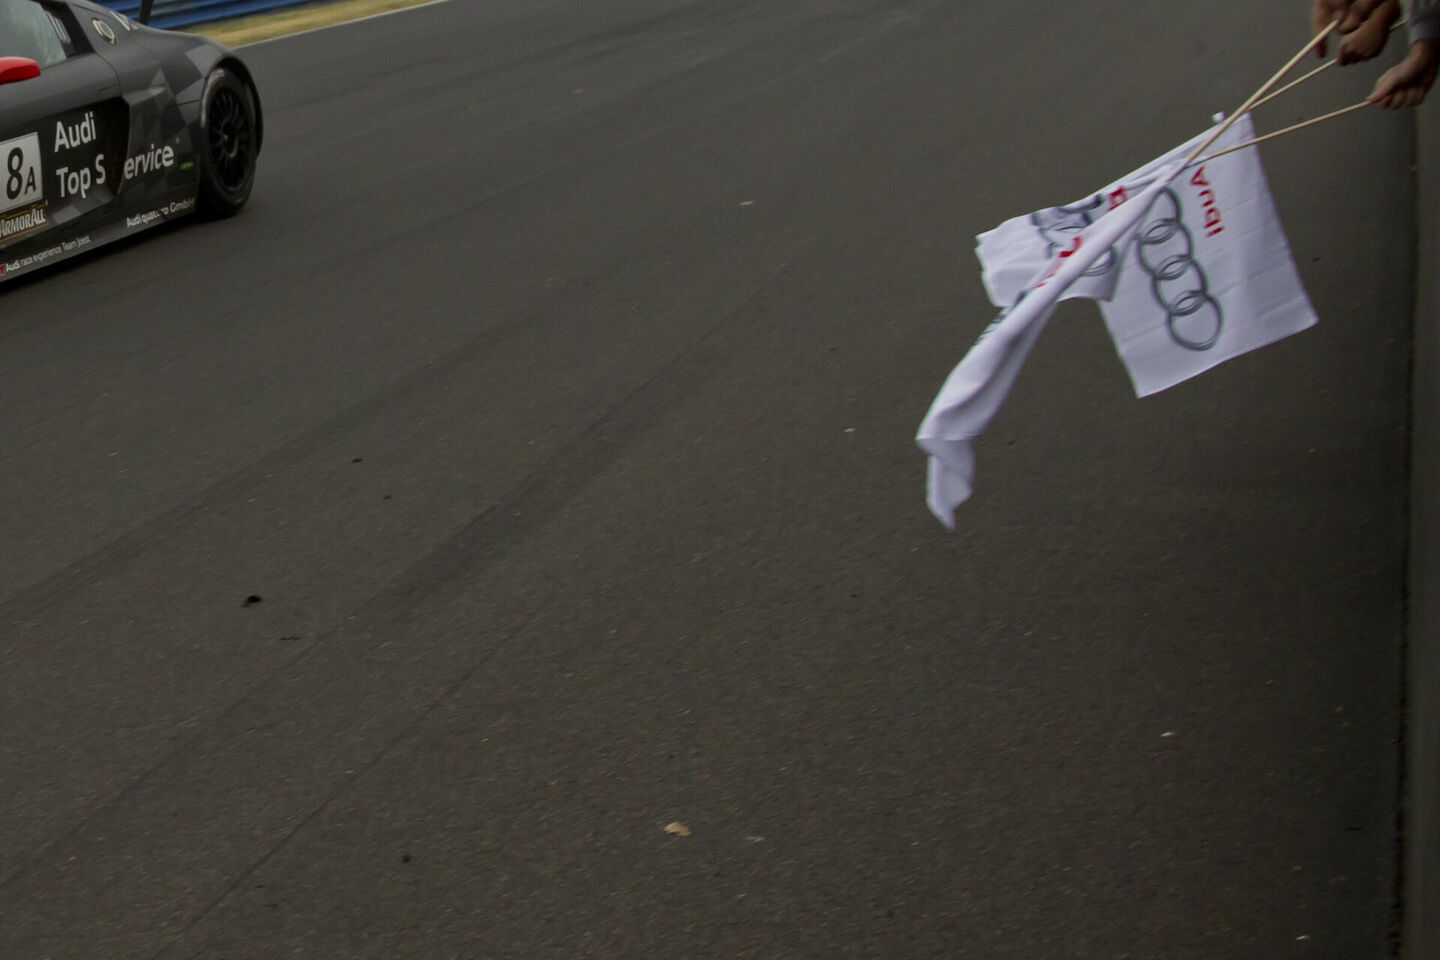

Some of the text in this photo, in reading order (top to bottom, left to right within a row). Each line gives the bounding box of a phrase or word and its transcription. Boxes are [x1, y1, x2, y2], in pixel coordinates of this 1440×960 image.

[54, 111, 97, 153] Audi
[56, 166, 91, 199] Top
[5, 259, 20, 272] Audi
